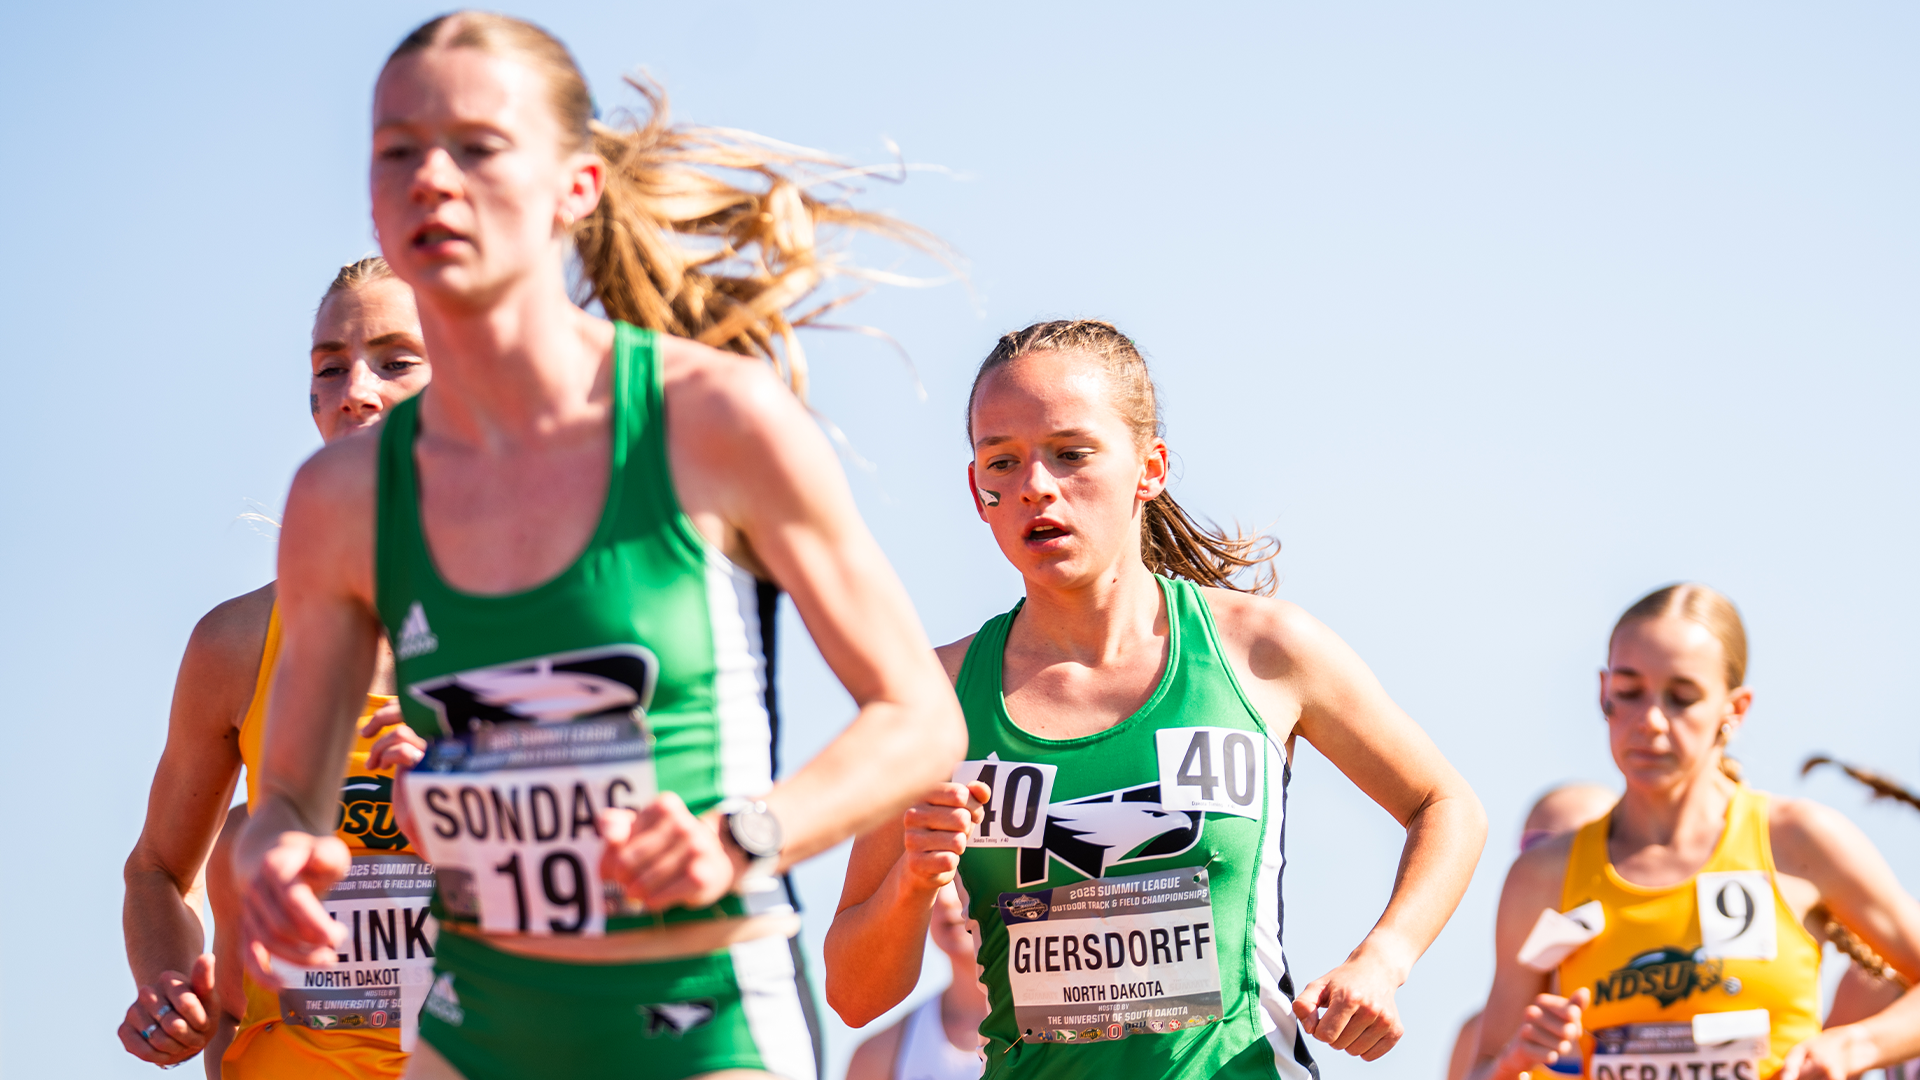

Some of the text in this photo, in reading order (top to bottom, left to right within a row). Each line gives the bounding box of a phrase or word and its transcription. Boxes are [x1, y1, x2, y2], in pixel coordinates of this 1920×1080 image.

[1177, 731, 1255, 806] 40
[977, 764, 1043, 838] 40
[371, 863, 416, 875] SUMMIT
[358, 880, 382, 890] TRACK
[384, 880, 391, 888] &
[392, 880, 414, 888] FIELD
[496, 850, 590, 932] 19
[1070, 877, 1180, 900] 2025 SUMMIT LEAGUE
[1052, 889, 1208, 912] OUTDOOR TRACK & FIELD CHAMPIONSHIPS
[1716, 880, 1754, 942] 9
[1014, 922, 1211, 974] GIERSDORFF
[305, 970, 351, 987] NORTH
[355, 968, 401, 987] DAKOT
[1594, 961, 1694, 1006] NDSU
[1063, 980, 1164, 1003] NORTH DAKOTA
[305, 1000, 322, 1010] THE
[324, 999, 377, 1010] UNIVERSITY
[378, 999, 389, 1009] OF
[1047, 1006, 1188, 1025] THE UNIVERSITY OF SOUTH DAKOTA
[1098, 1003, 1130, 1012] HOSTED BY
